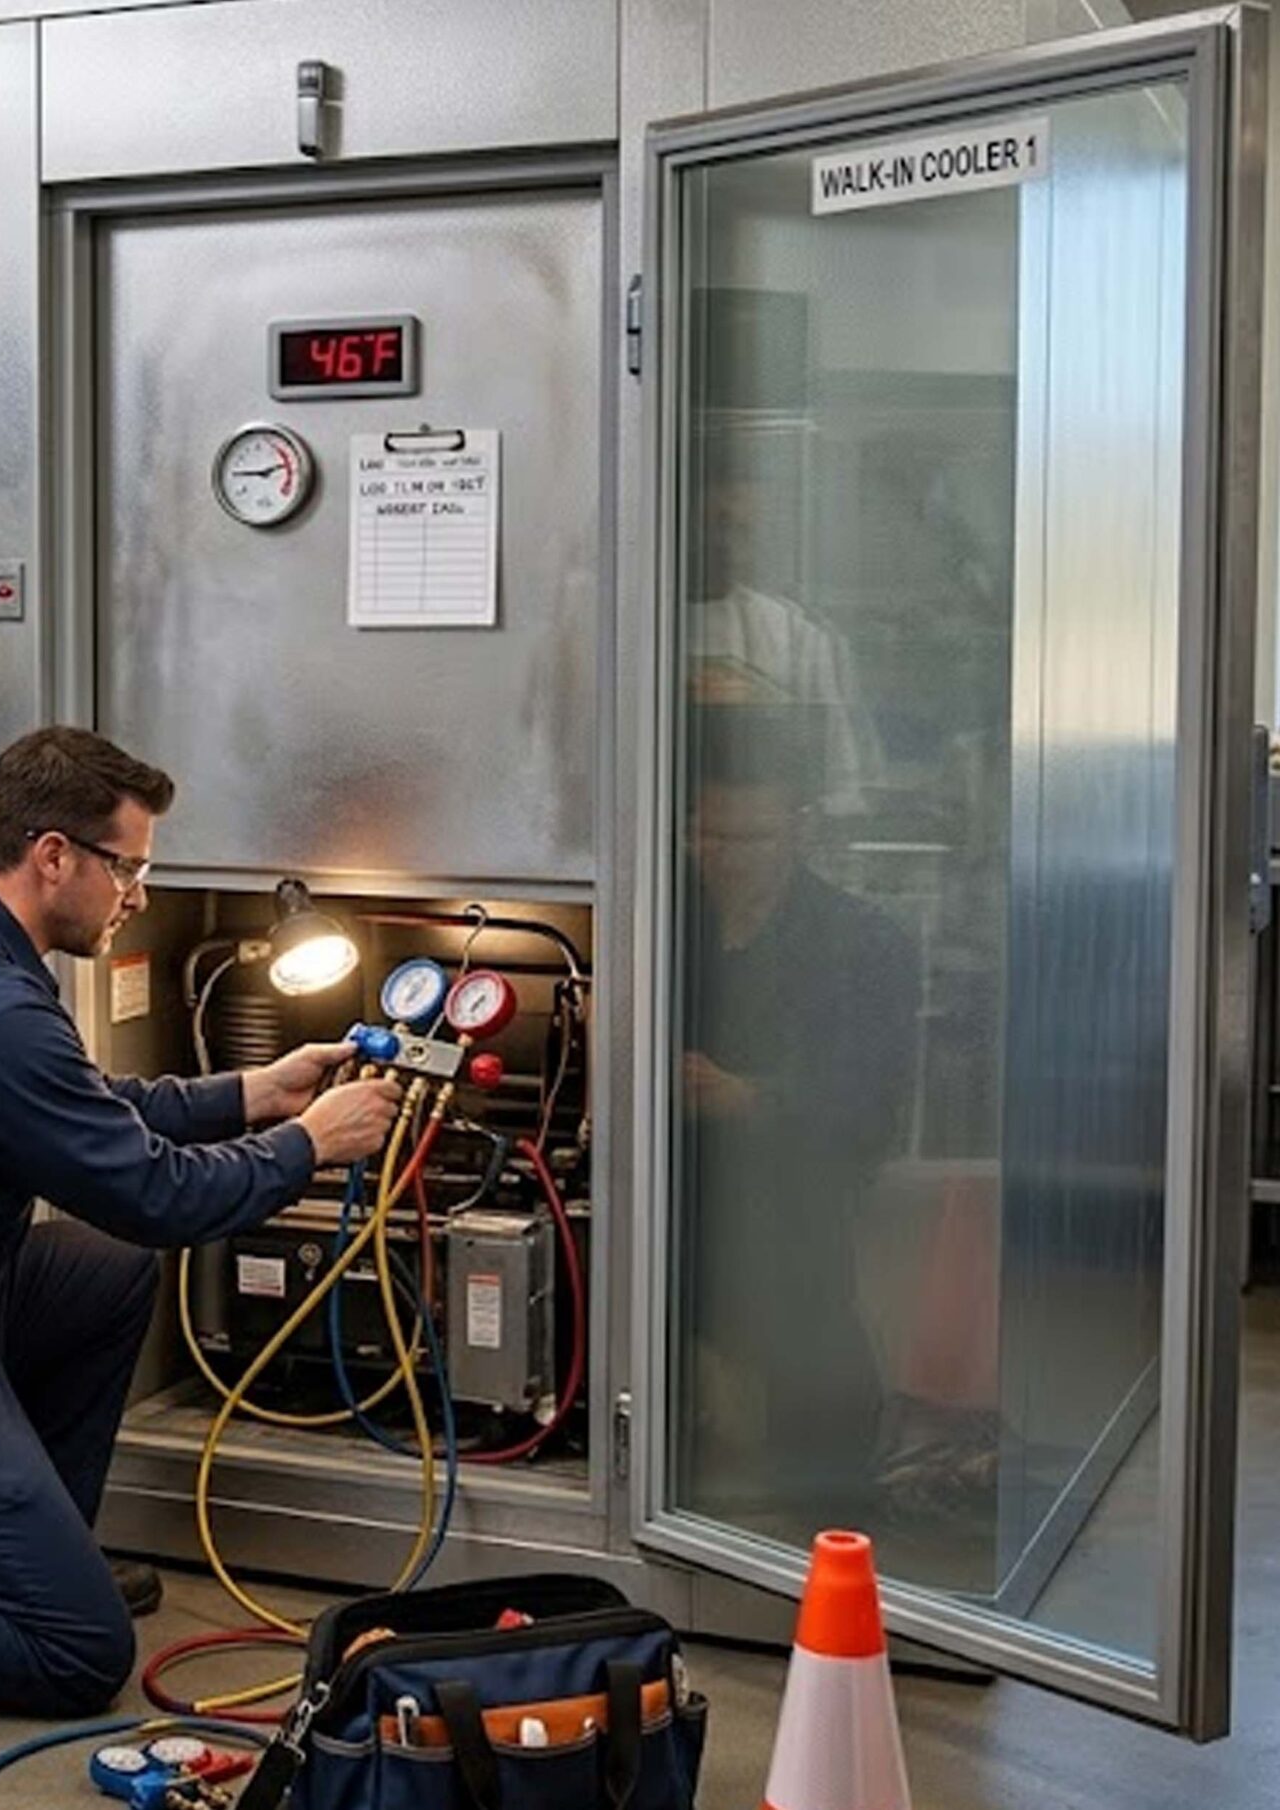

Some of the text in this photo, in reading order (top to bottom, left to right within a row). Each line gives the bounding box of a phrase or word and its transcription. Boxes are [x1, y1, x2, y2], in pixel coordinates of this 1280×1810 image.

[821, 135, 1036, 198] WALK-IN COOLER 1
